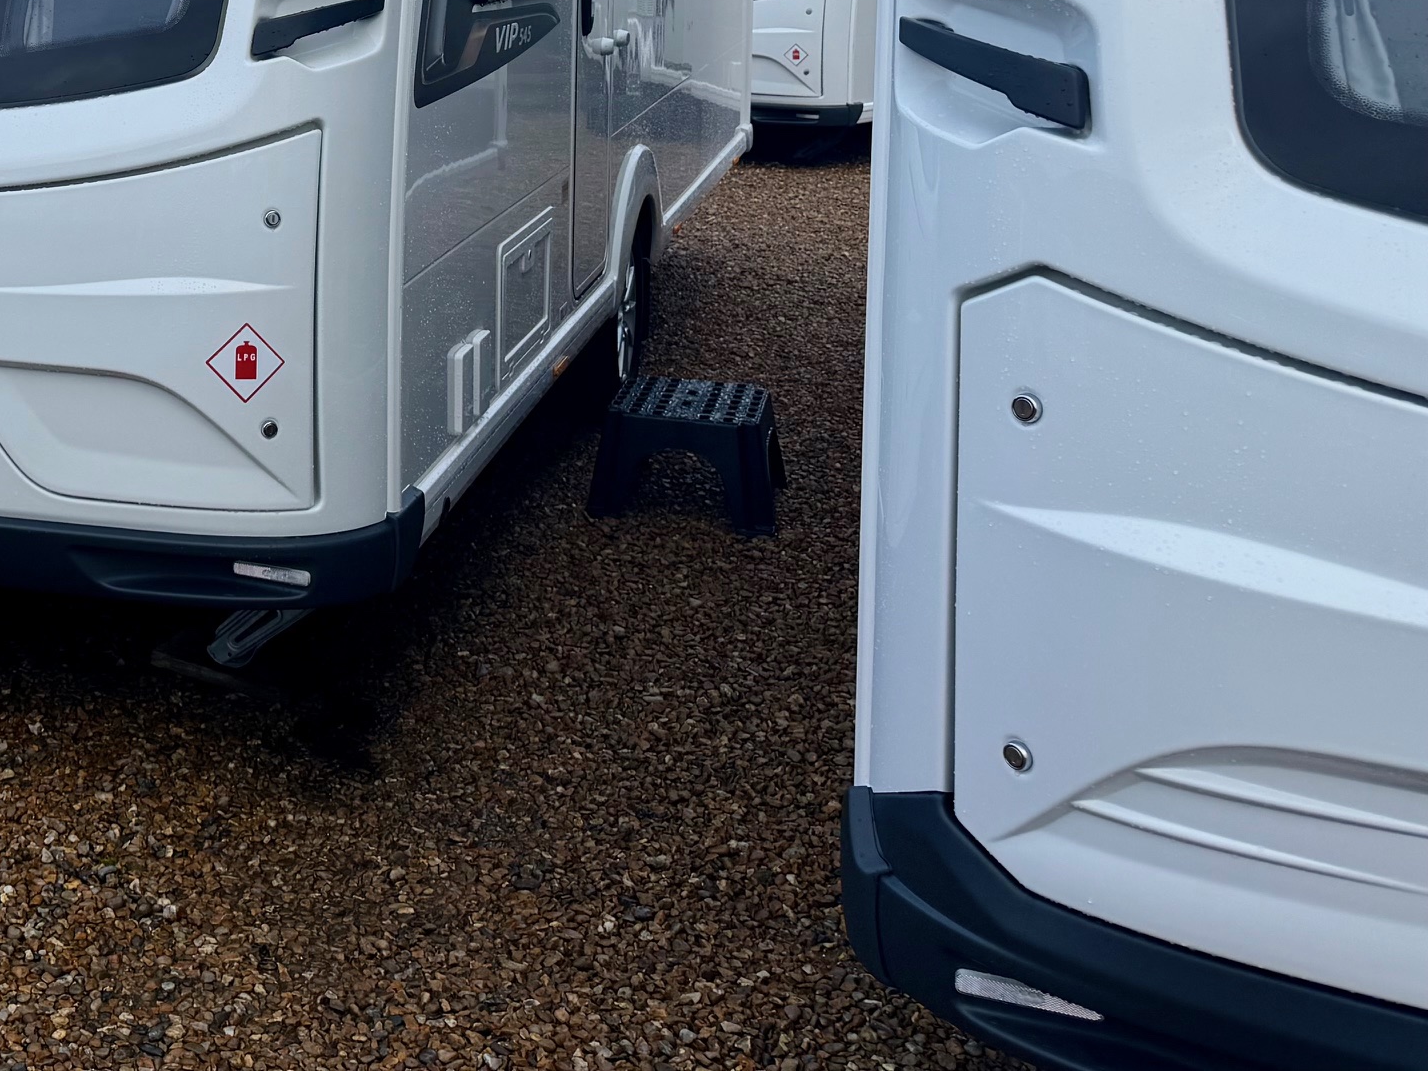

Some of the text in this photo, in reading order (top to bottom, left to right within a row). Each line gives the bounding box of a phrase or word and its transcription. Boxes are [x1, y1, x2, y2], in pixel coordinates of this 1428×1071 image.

[495, 22, 532, 54] VIP 545
[237, 353, 256, 361] LPG
